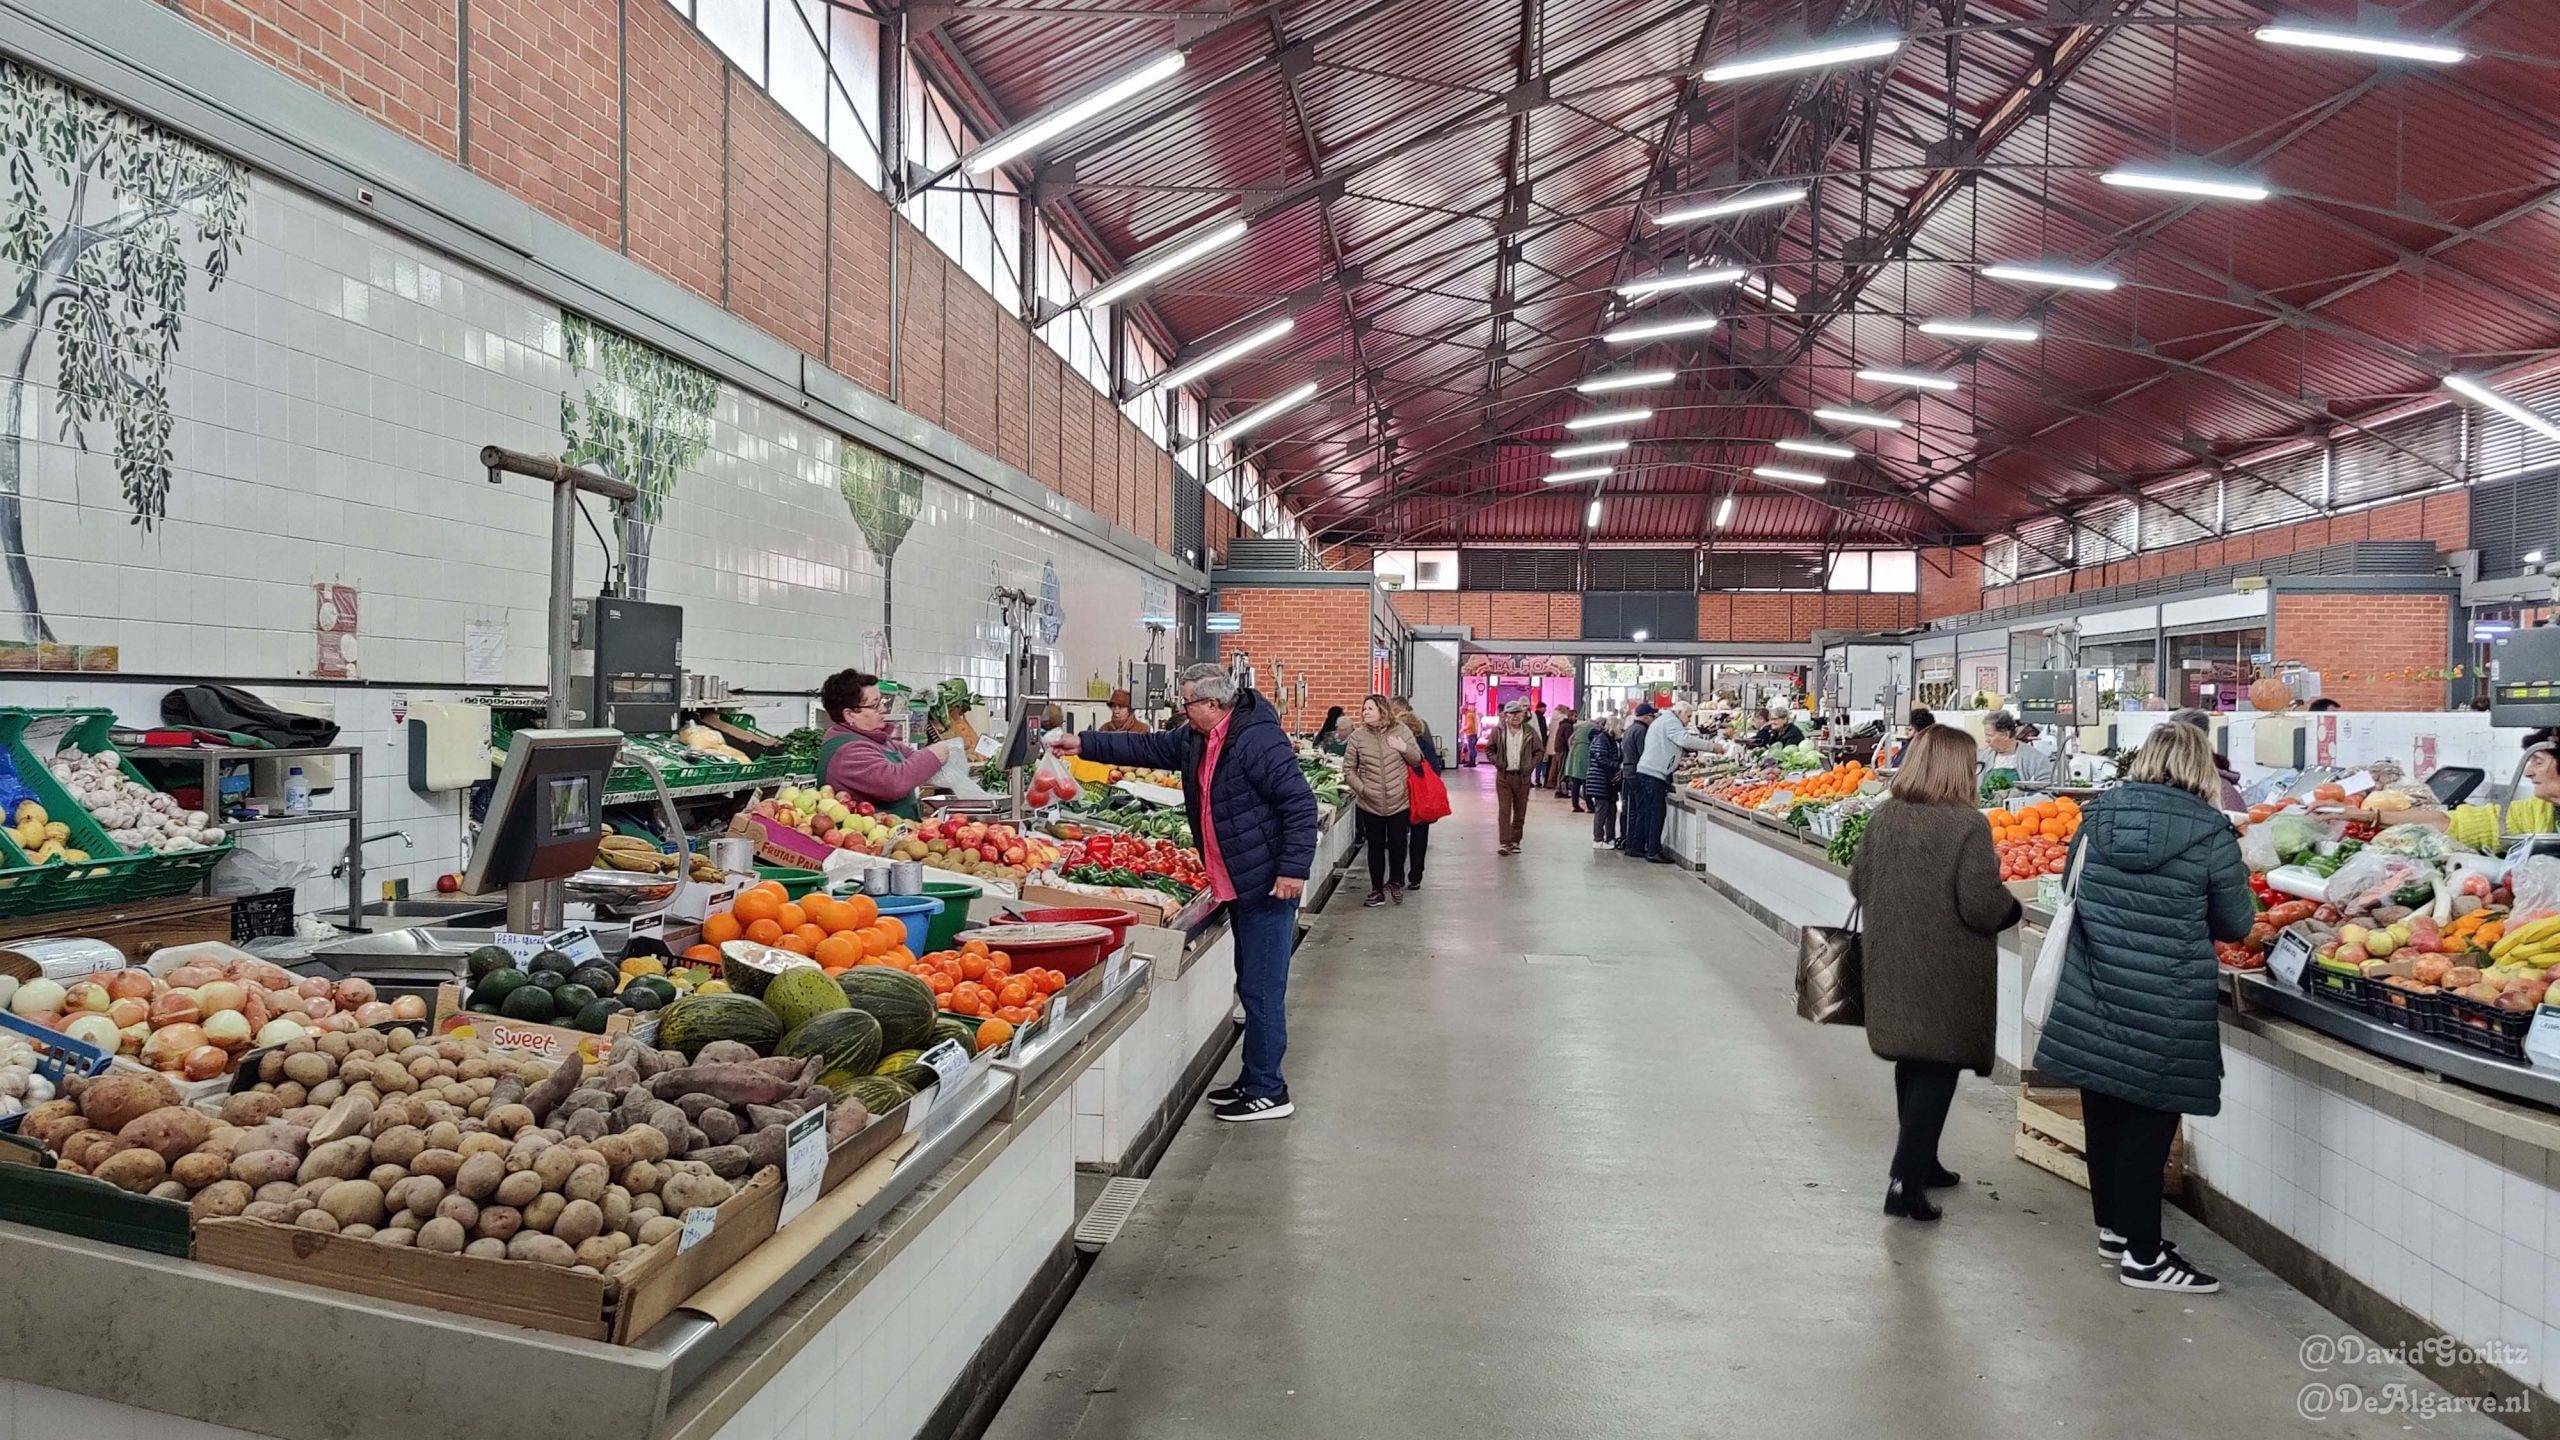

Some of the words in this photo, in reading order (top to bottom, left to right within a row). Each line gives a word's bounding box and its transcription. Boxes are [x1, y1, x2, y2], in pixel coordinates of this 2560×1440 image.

[1493, 659, 1545, 673] TALHO
[761, 842, 796, 864] FRUTAS
[494, 1027, 557, 1053] Sweet
